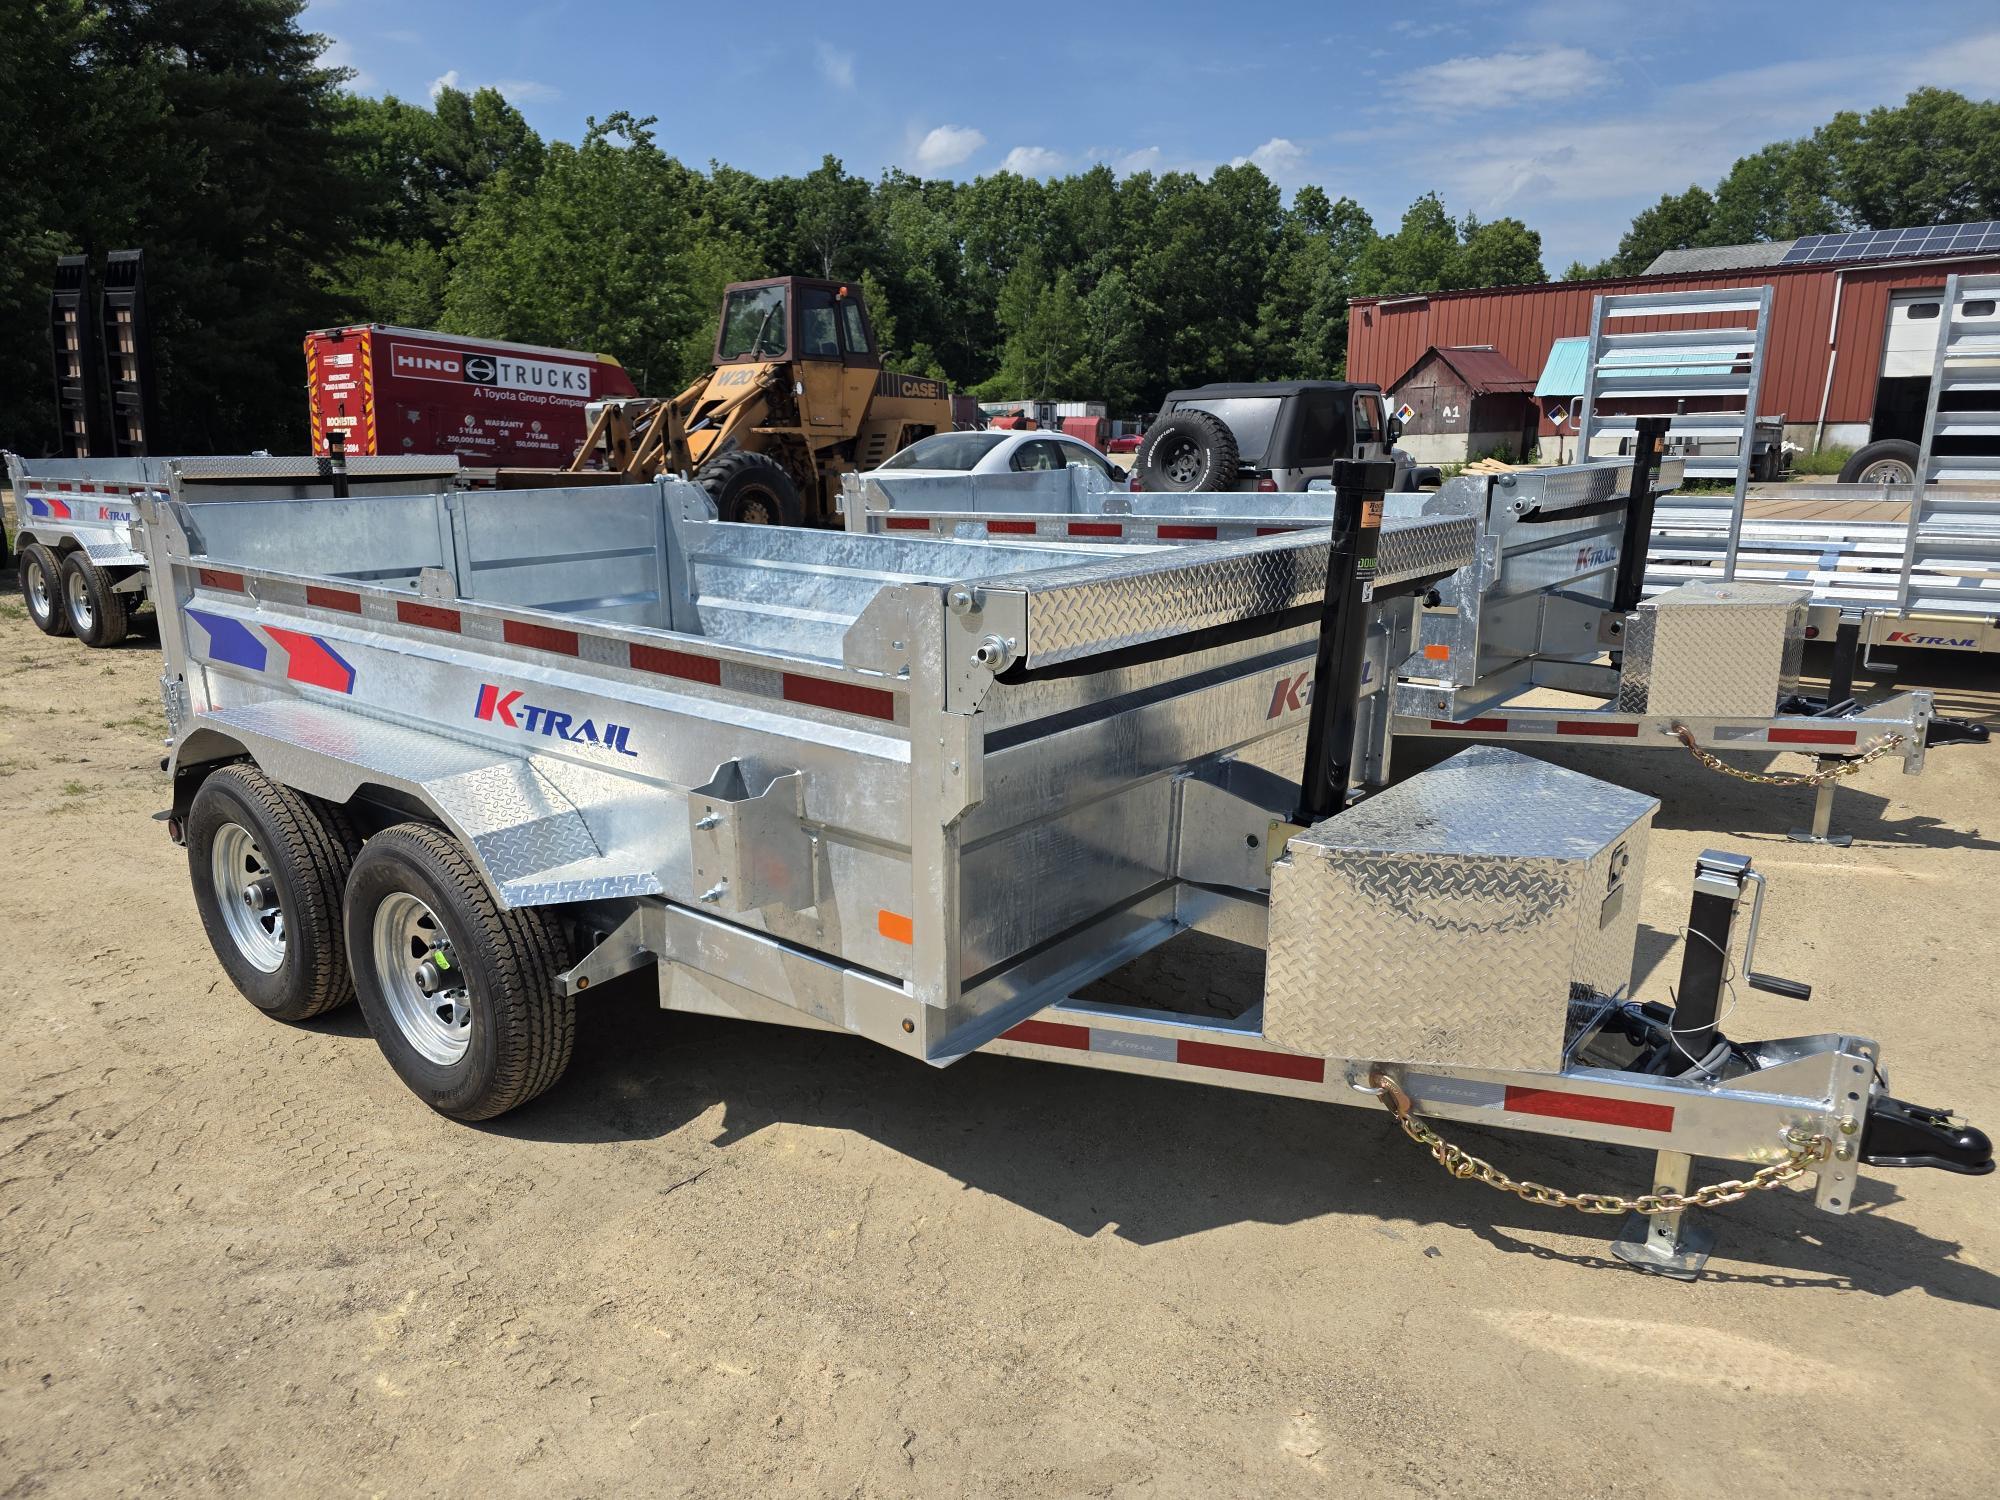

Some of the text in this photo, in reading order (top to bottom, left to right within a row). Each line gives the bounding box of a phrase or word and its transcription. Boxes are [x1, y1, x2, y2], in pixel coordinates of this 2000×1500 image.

[398, 356, 460, 373] HINO
[500, 364, 587, 390] TRUCKS
[717, 369, 755, 386] W20
[473, 387, 482, 397] A
[483, 388, 516, 401] Toyota
[518, 391, 547, 405] Group
[901, 381, 937, 398] CASE
[1442, 406, 1460, 418] A1
[463, 427, 483, 435] YEAR
[484, 419, 525, 428] WARRANTY
[447, 435, 496, 445] 250,000 MILES
[530, 432, 549, 440] YEAR
[515, 440, 560, 450] 150,000 MILES
[1147, 427, 1175, 468] BFGoodrich
[1575, 546, 1617, 571] K-TRAIL
[1886, 631, 1977, 648] K-TRAIL
[473, 683, 638, 757] K-TRAIL
